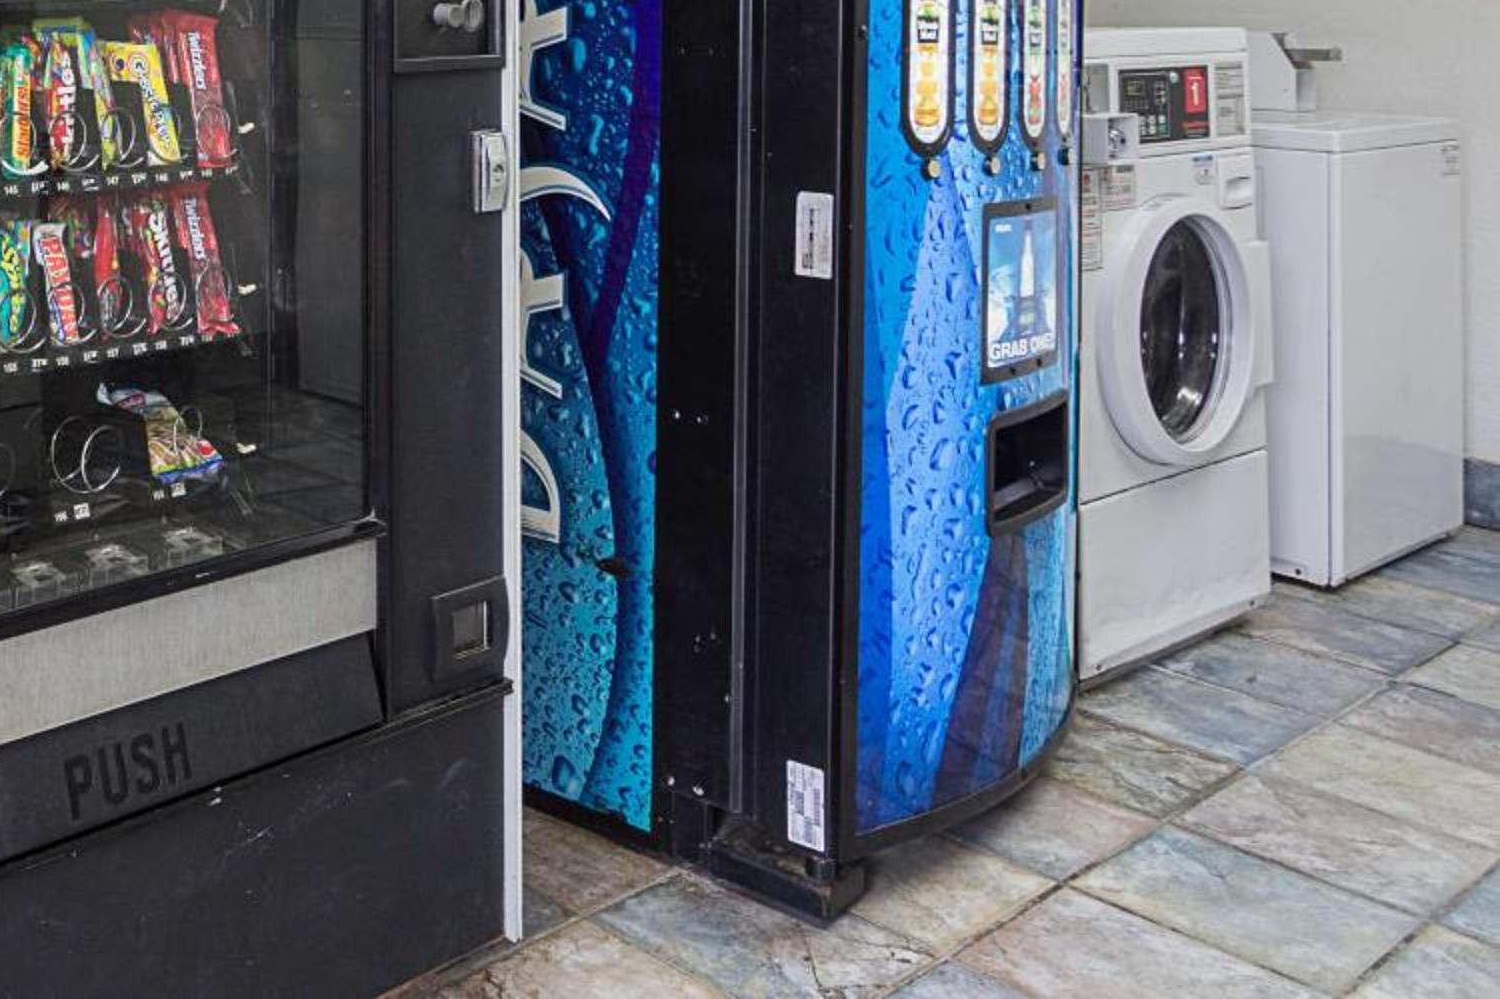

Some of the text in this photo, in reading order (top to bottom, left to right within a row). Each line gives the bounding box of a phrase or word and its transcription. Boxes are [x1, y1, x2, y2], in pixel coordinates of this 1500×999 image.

[1190, 80, 1200, 106] 1
[989, 337, 1028, 361] GRAB
[63, 721, 193, 821] PUSH
